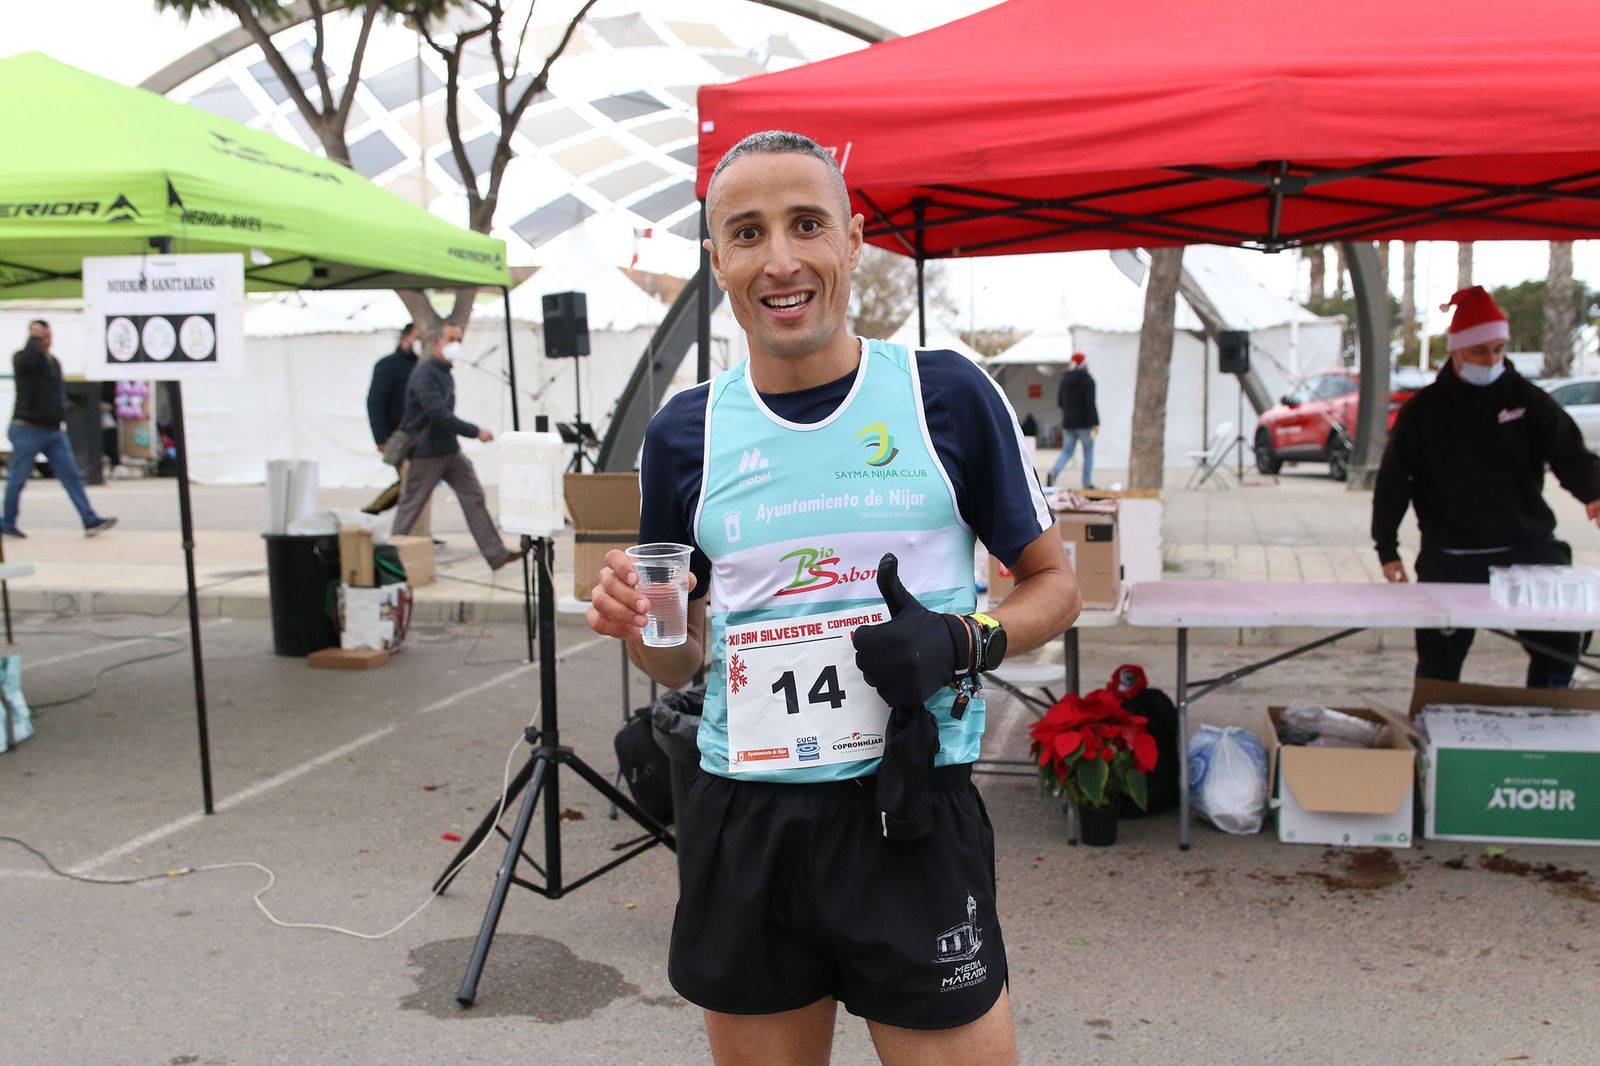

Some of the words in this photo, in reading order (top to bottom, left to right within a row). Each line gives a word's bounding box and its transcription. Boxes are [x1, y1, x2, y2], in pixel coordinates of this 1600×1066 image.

[152, 275, 216, 292] SANITARIAS
[738, 470, 771, 489] mobel
[834, 470, 870, 480] SAYMA
[871, 469, 899, 480] NIJAR
[900, 469, 928, 478] CLUB
[755, 492, 859, 524] Ayuntamiento
[864, 489, 883, 507] de
[888, 488, 926, 511] Níjar
[779, 546, 834, 589] Bio
[740, 631, 758, 645] SAN
[760, 623, 824, 643] SILVESTRE
[827, 615, 870, 630] COMARCA
[871, 613, 883, 624] DE
[771, 664, 846, 715] 14
[954, 960, 982, 976] MEDIA
